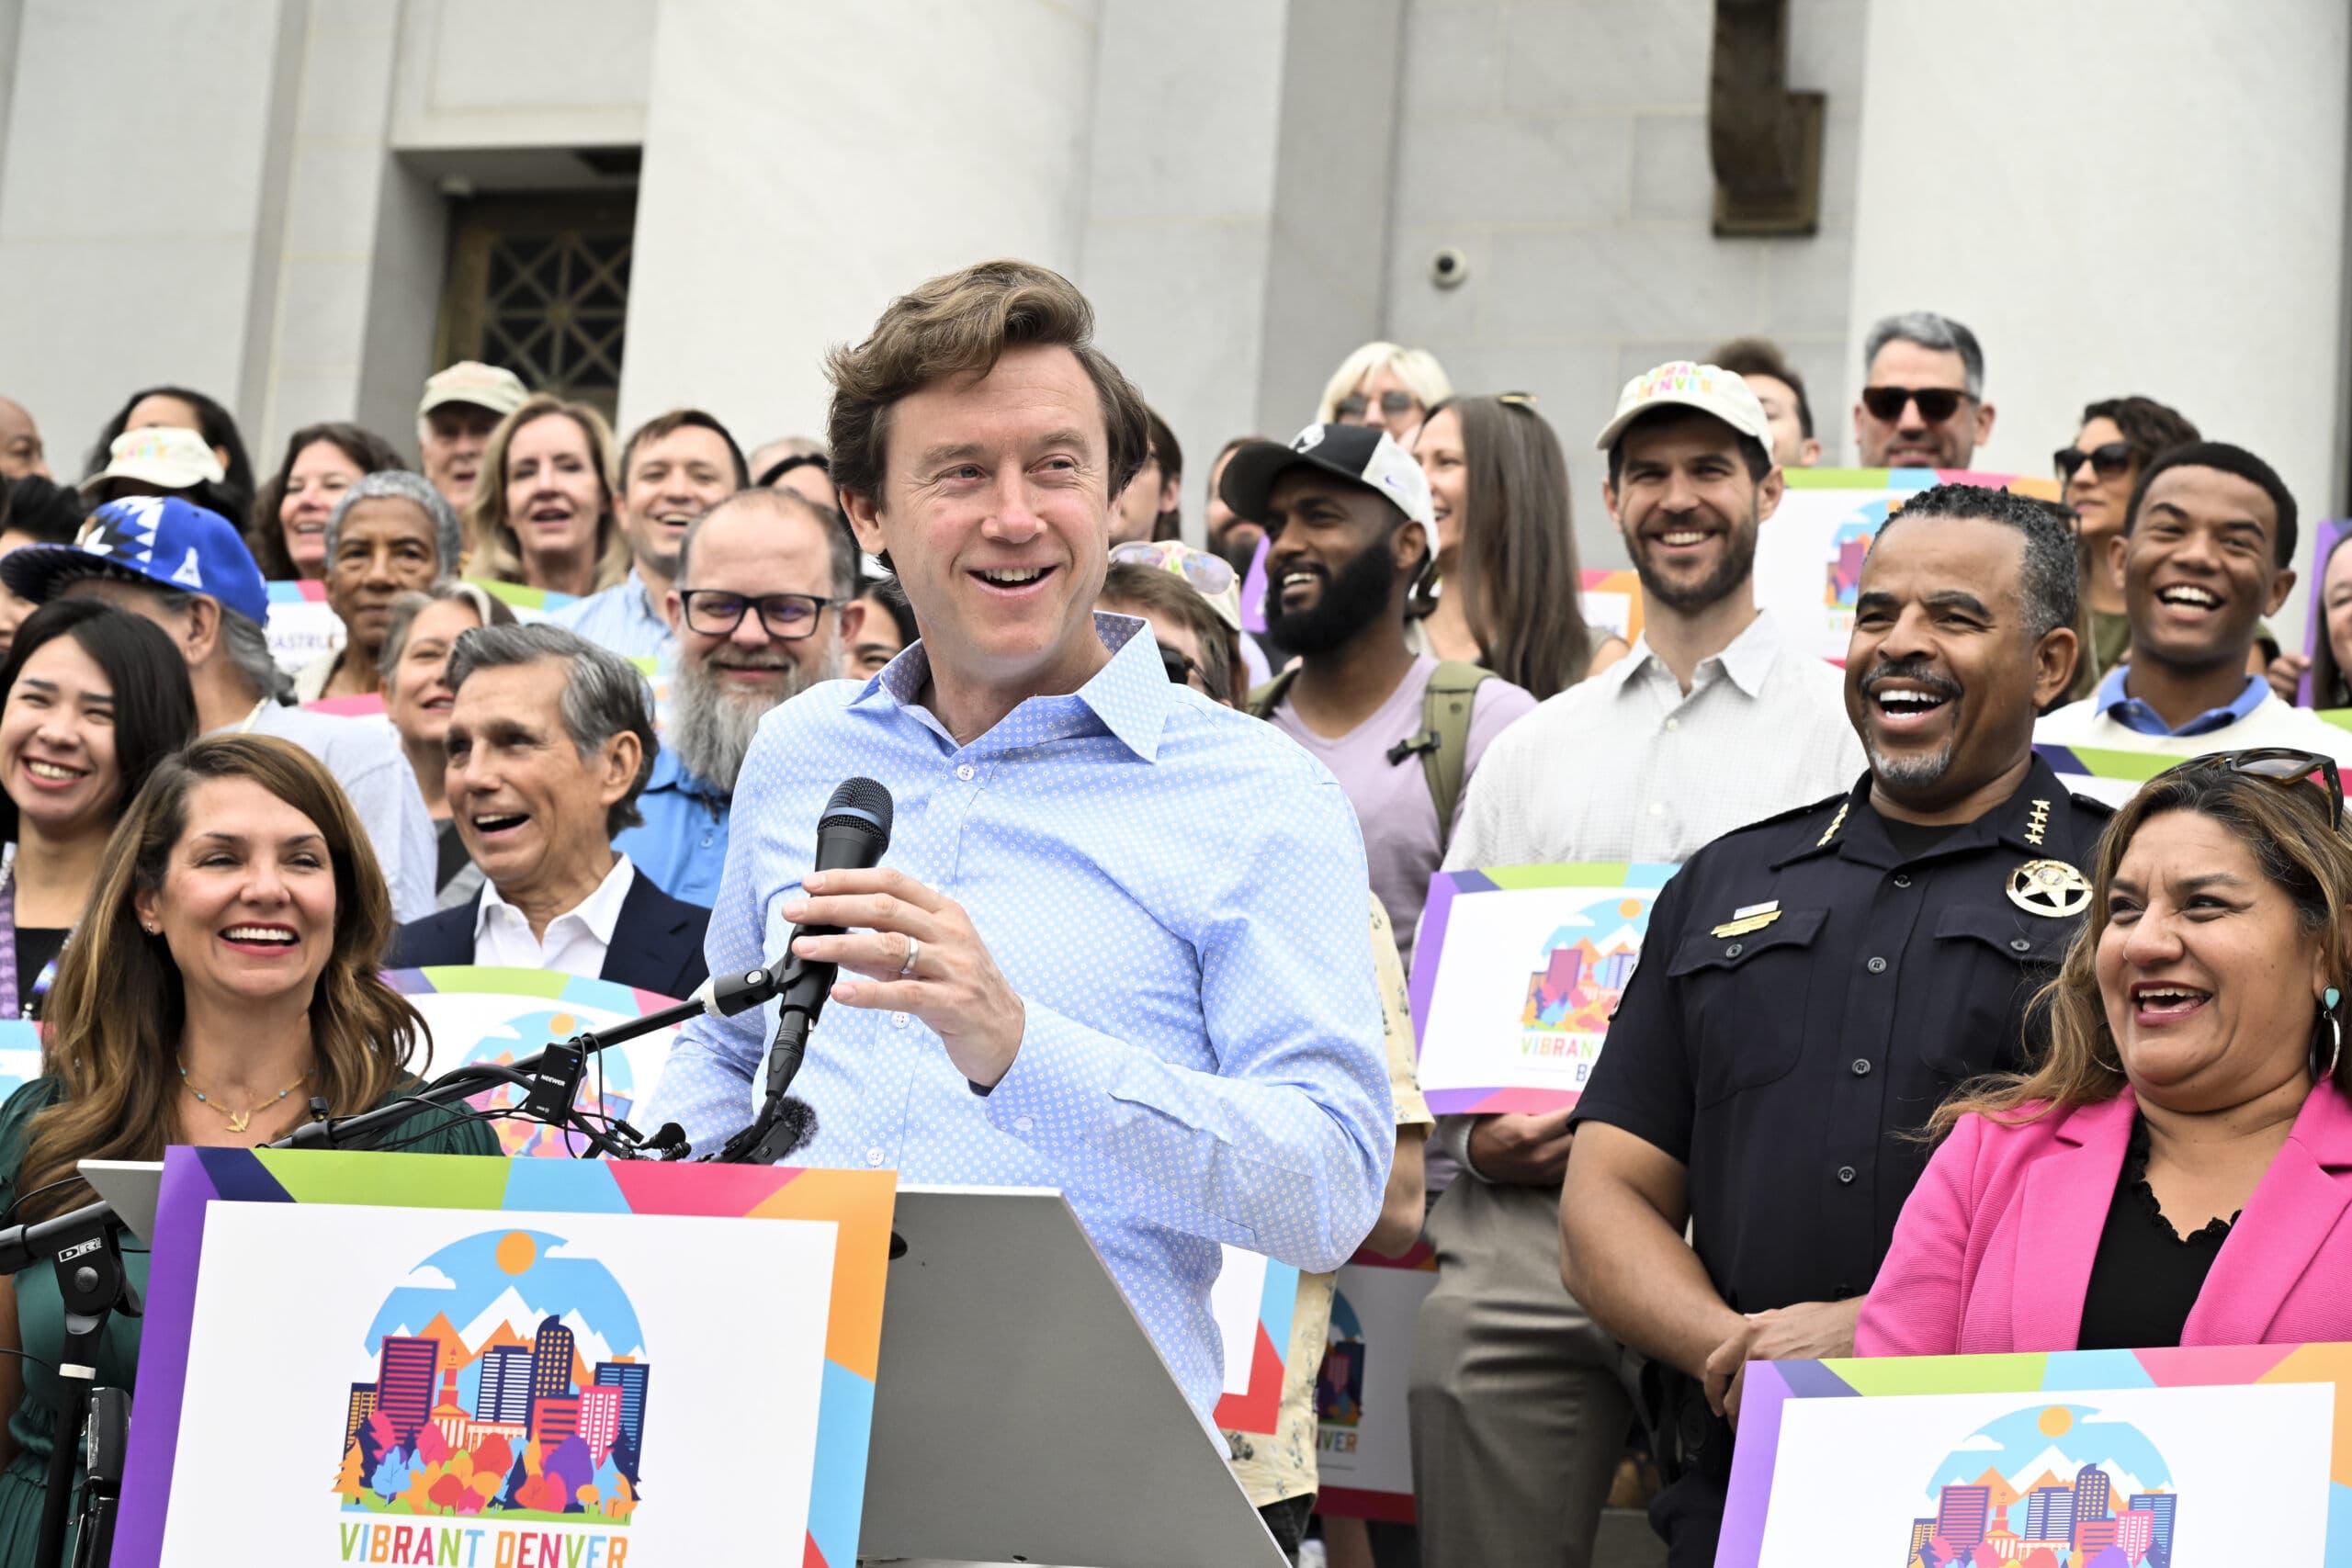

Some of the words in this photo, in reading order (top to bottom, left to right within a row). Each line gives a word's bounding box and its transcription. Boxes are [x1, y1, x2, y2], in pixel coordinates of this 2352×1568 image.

[540, 1074, 566, 1088] NEEWER
[340, 1522, 485, 1568] VIBRANT
[493, 1530, 628, 1568] DENVER
